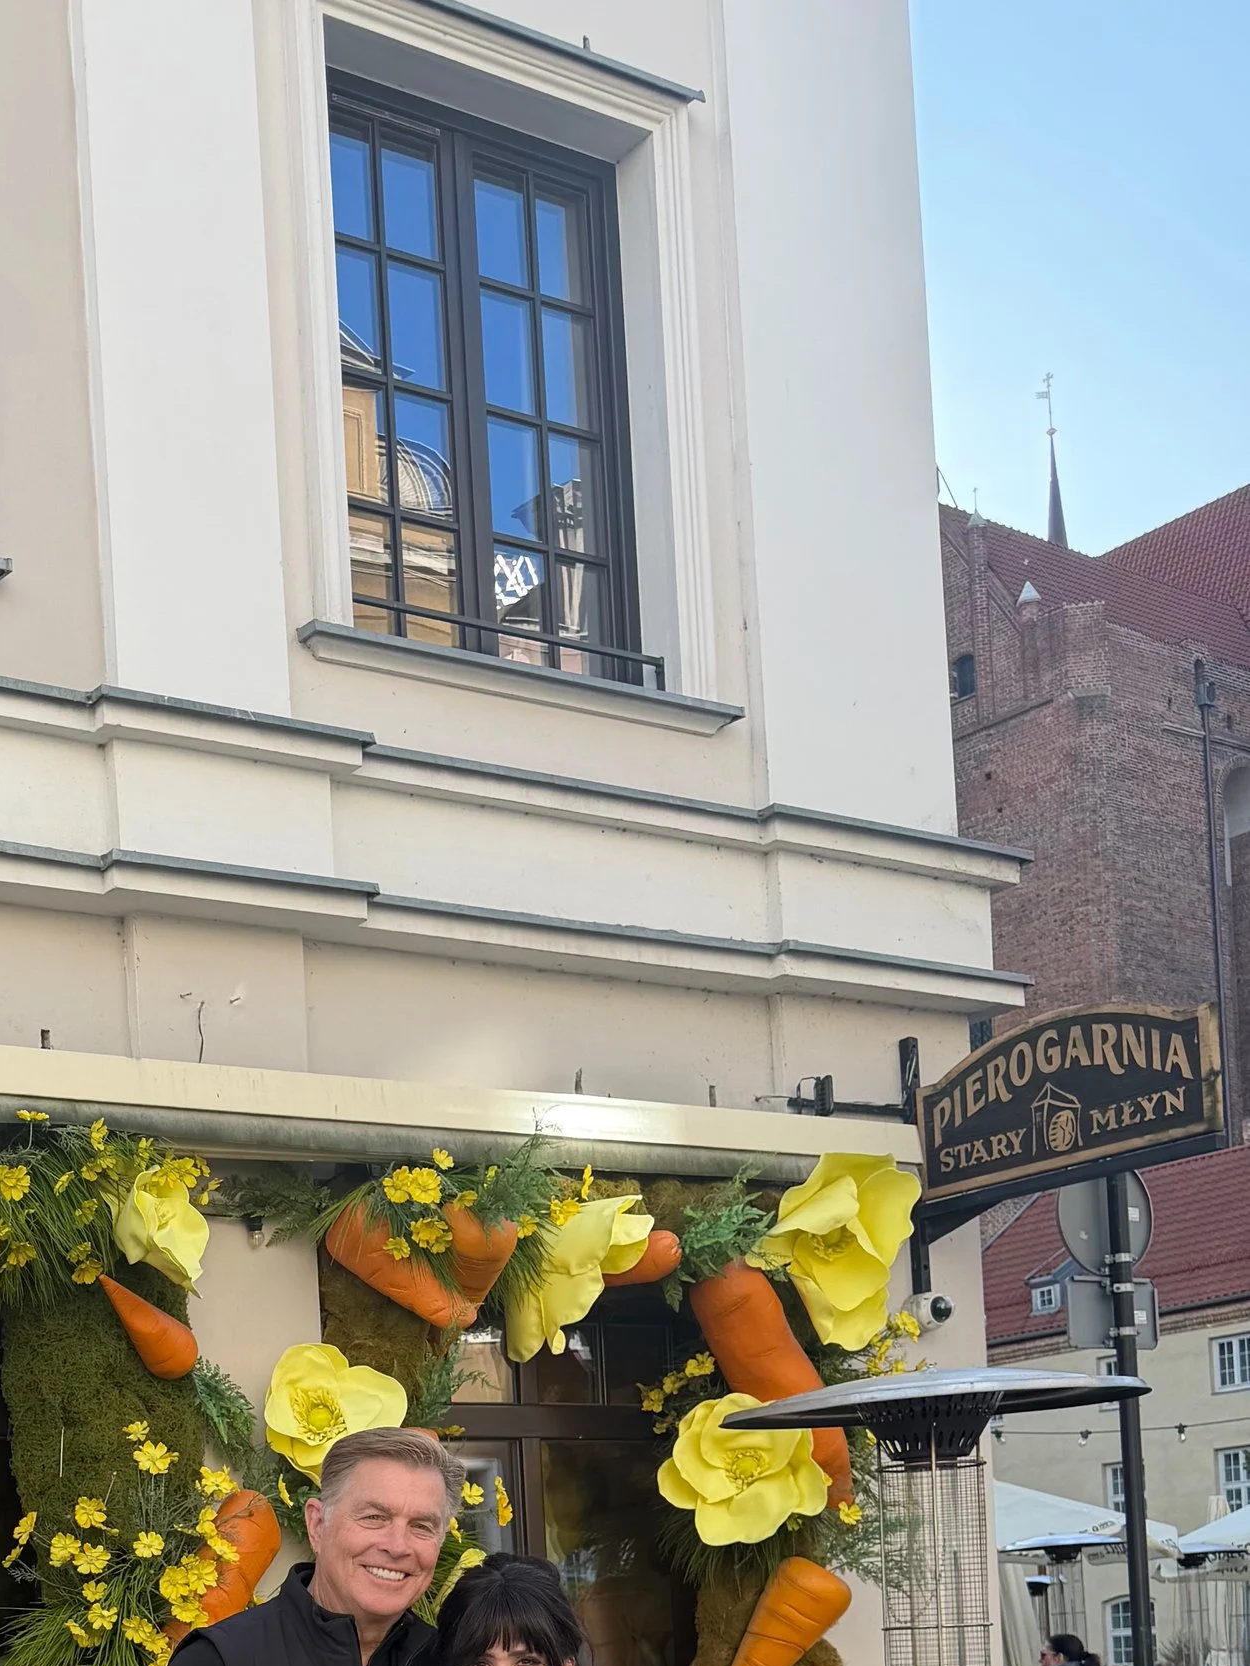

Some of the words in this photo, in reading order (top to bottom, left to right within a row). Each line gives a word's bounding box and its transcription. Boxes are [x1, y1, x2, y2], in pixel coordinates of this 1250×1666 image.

[933, 1023, 1194, 1148] PIEROGARNIA
[940, 1128, 1027, 1173] STARY
[1089, 1086, 1186, 1135] MŁYN
